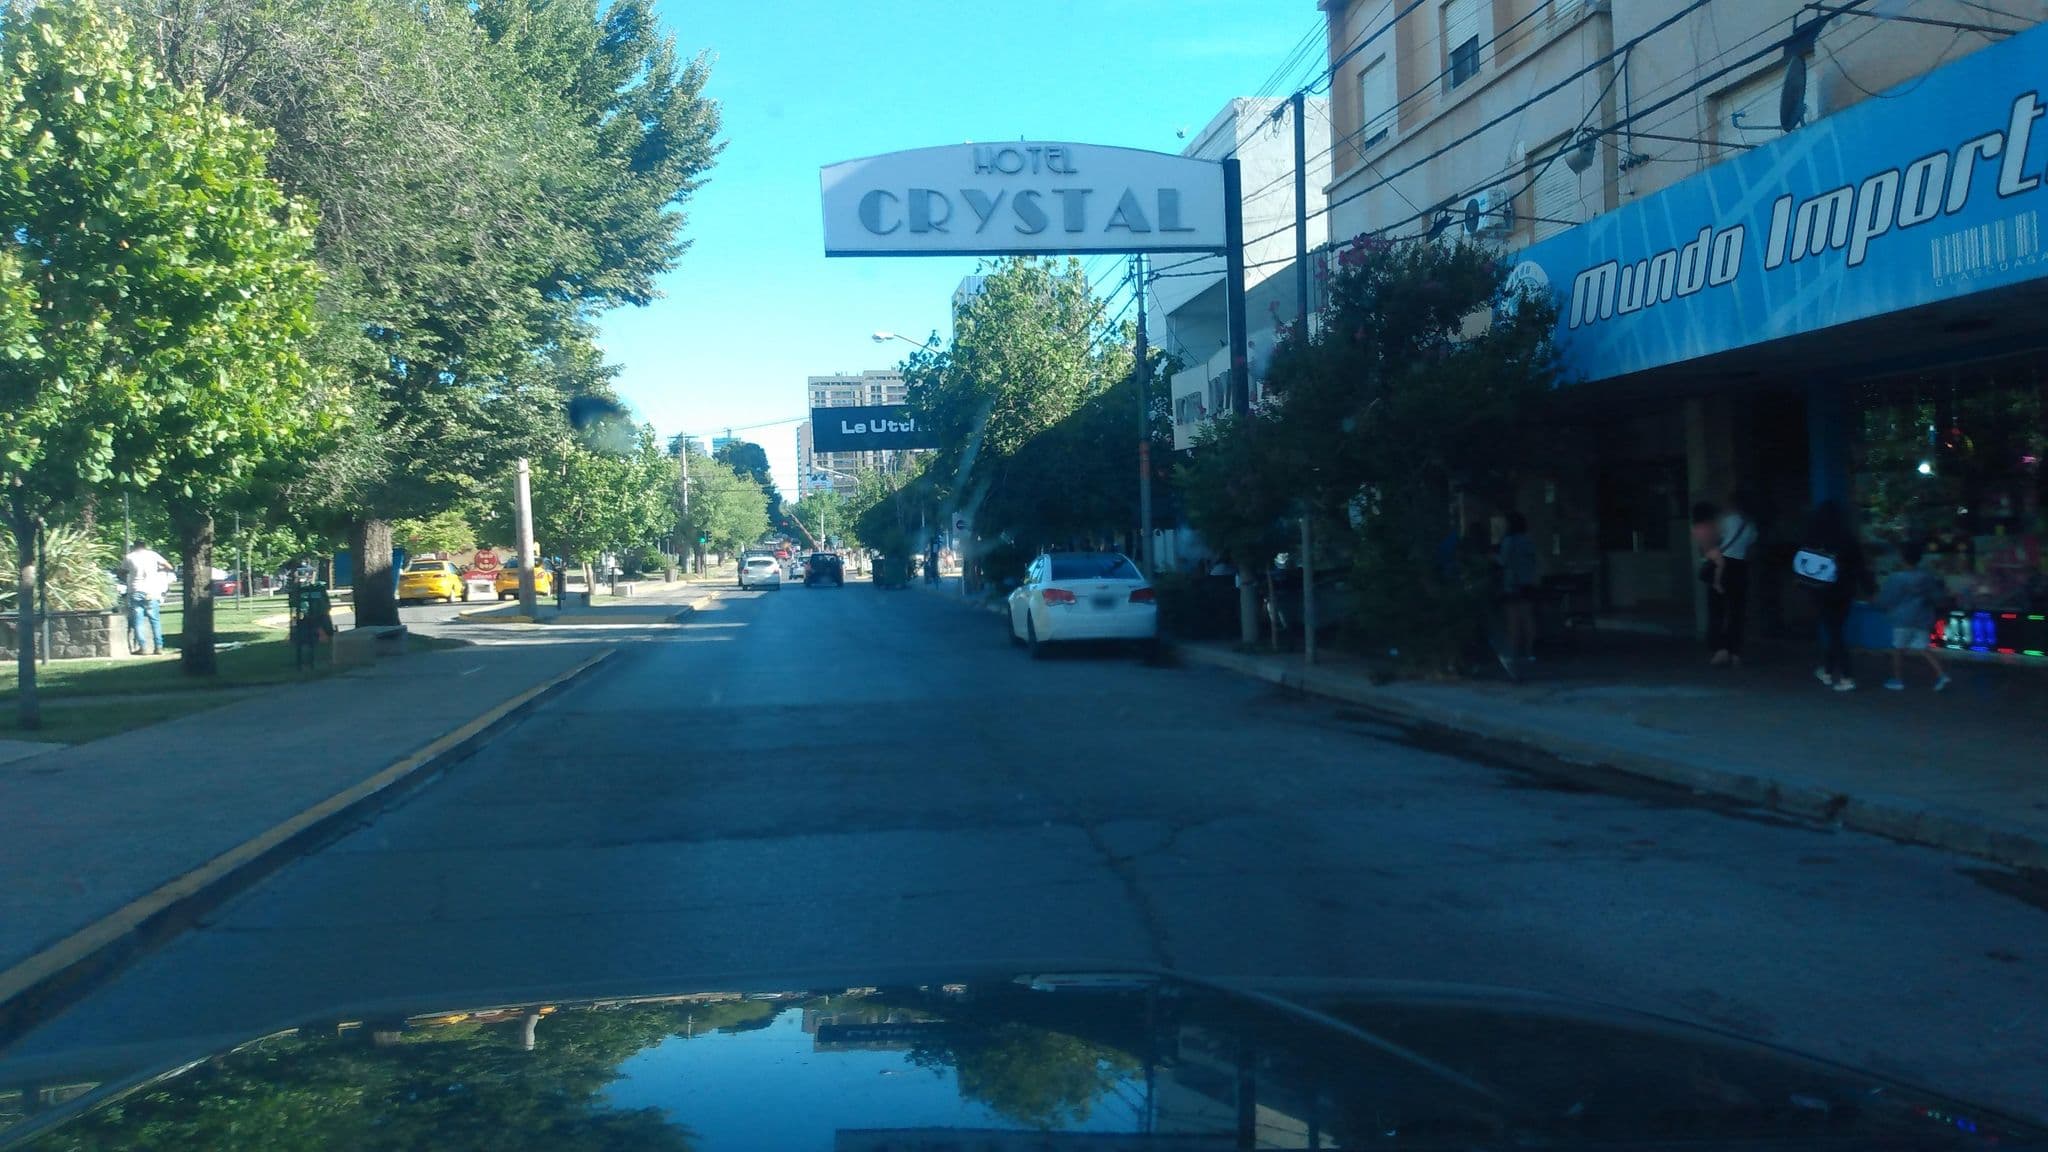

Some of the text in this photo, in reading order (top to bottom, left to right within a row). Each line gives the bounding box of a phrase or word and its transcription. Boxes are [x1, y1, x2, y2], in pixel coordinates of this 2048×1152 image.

[973, 146, 1079, 176] HOTEL
[858, 187, 1196, 236] CRYSTAL
[1568, 88, 2048, 330] Mundo Import
